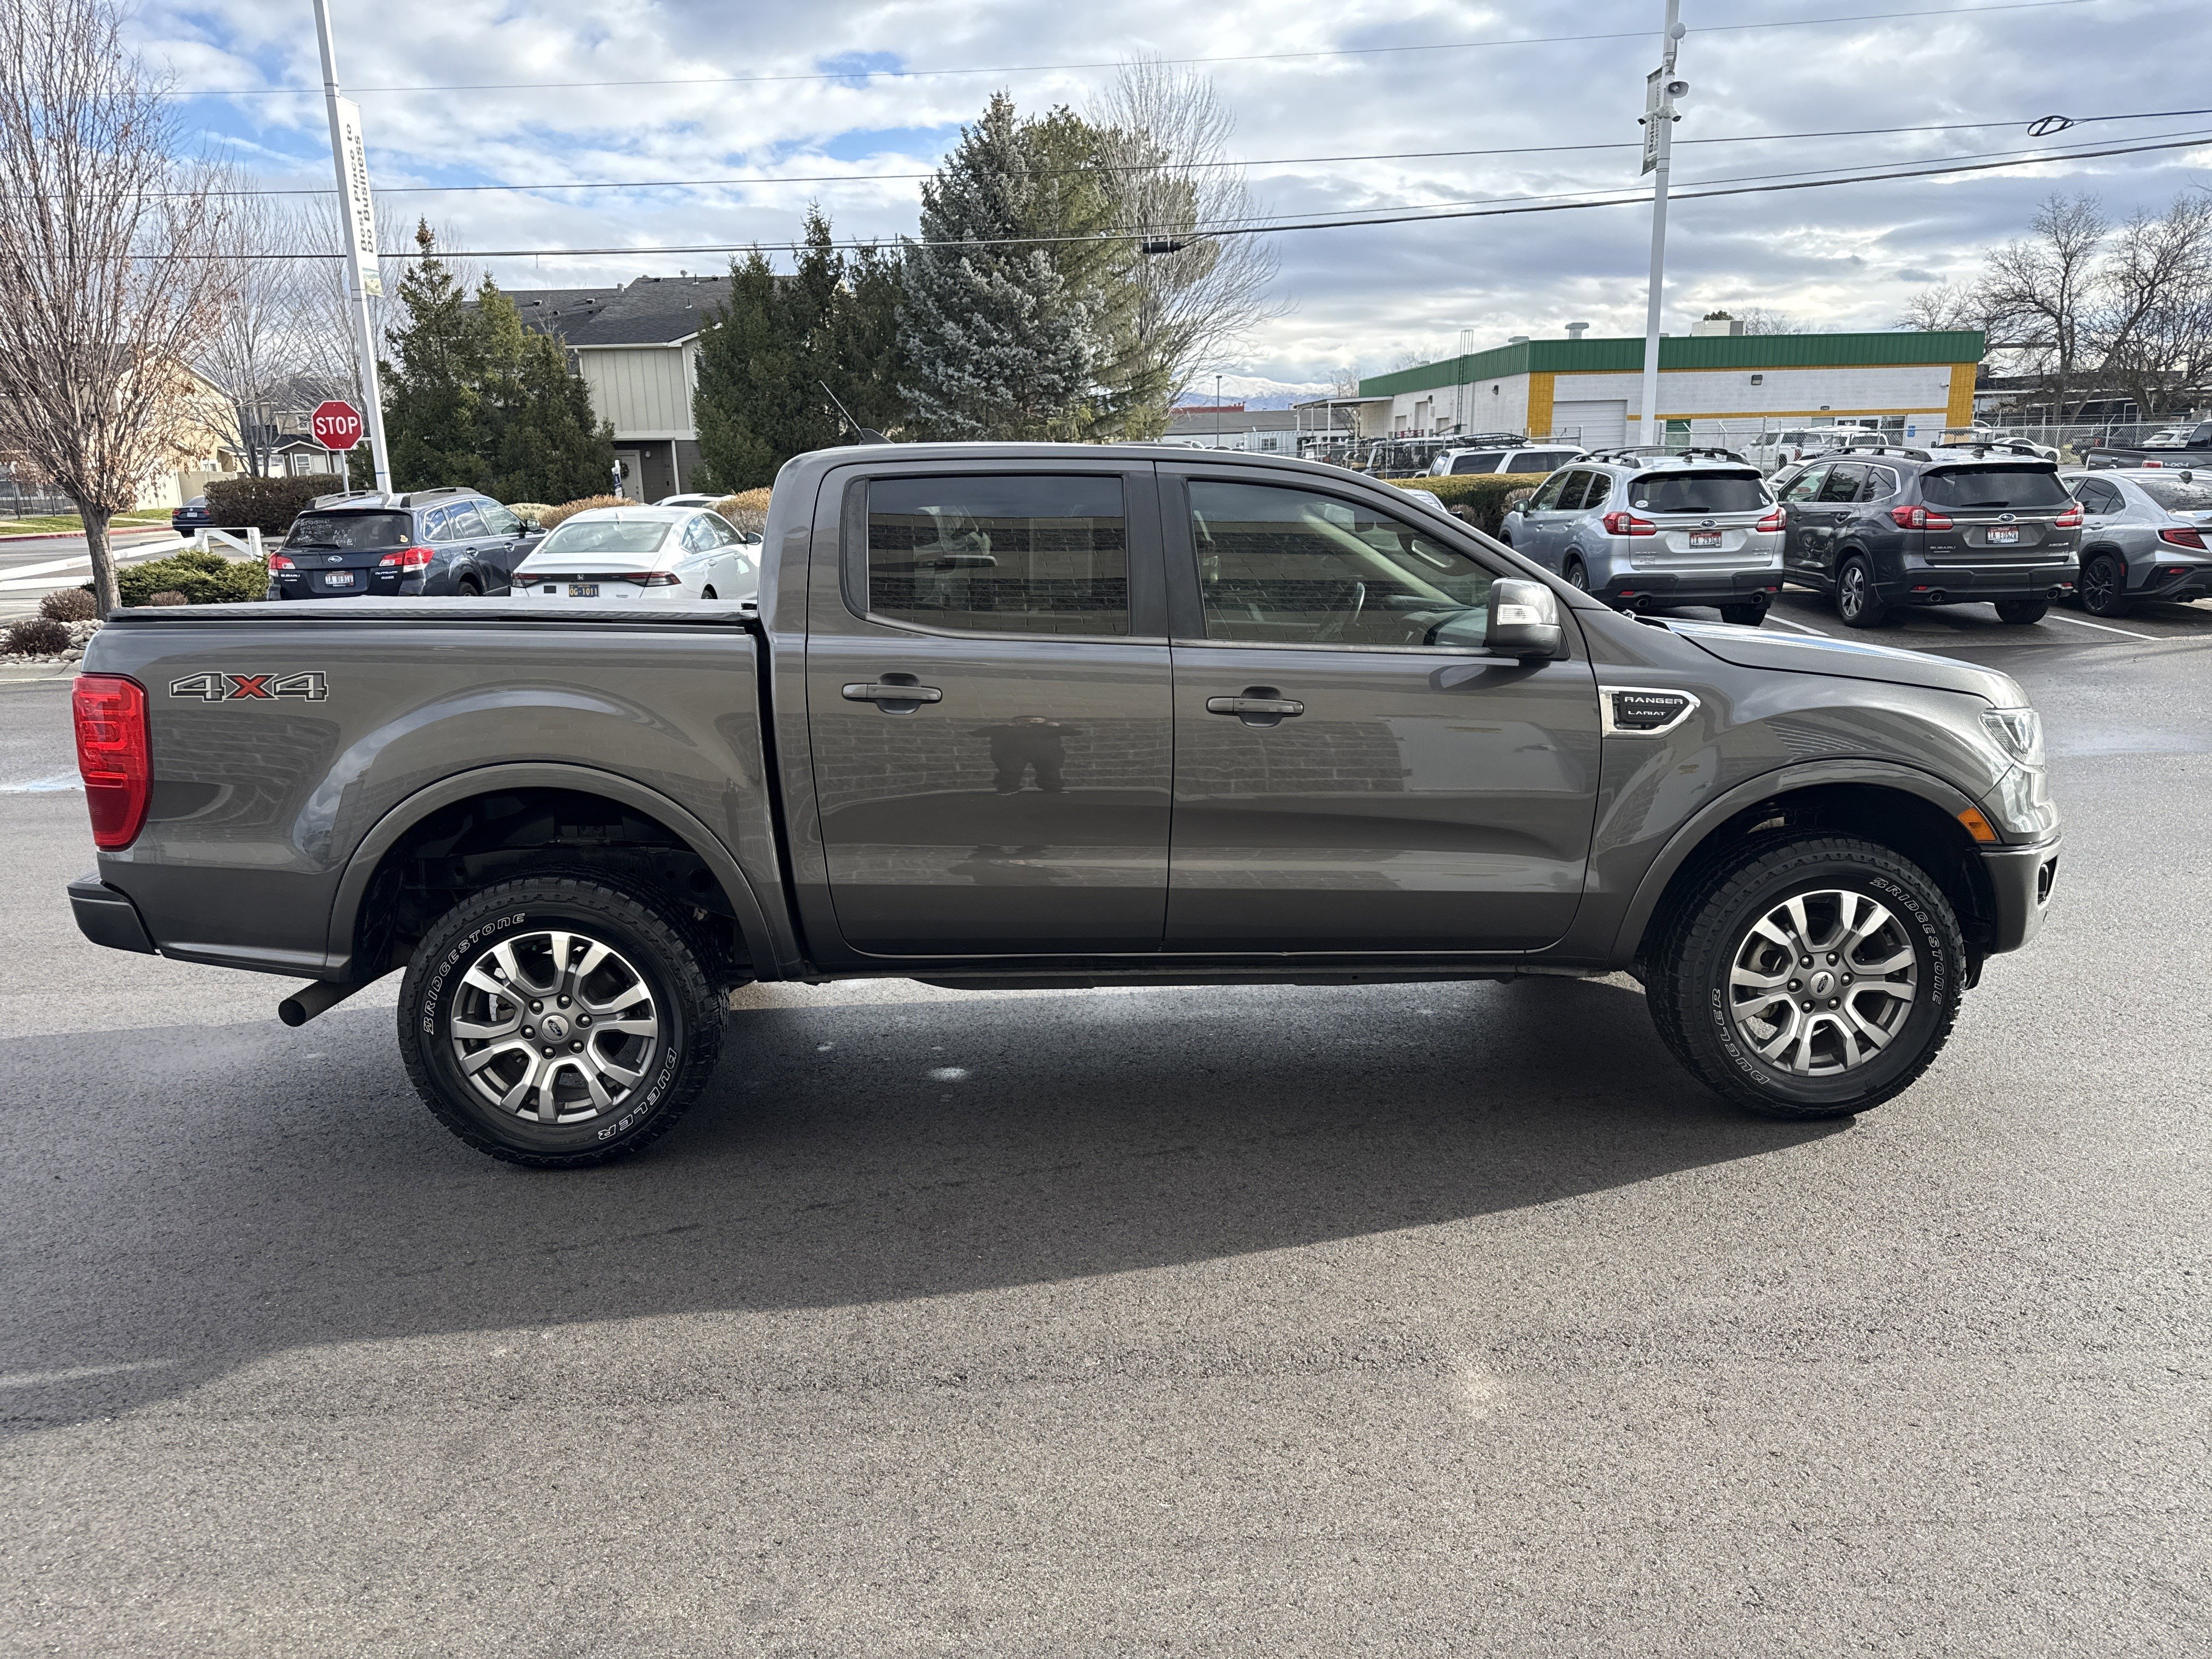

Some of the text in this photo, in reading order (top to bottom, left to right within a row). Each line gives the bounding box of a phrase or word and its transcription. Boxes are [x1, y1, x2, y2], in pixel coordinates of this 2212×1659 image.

[346, 123, 367, 251] Best Place to
[355, 136, 374, 253] Do Business
[316, 416, 358, 435] STOP
[423, 912, 526, 1035] BRIDGESTONE
[1869, 877, 1945, 1006] BRIDGESTONE
[597, 1047, 678, 1141] DUELER
[1711, 988, 1770, 1085] DUELER
